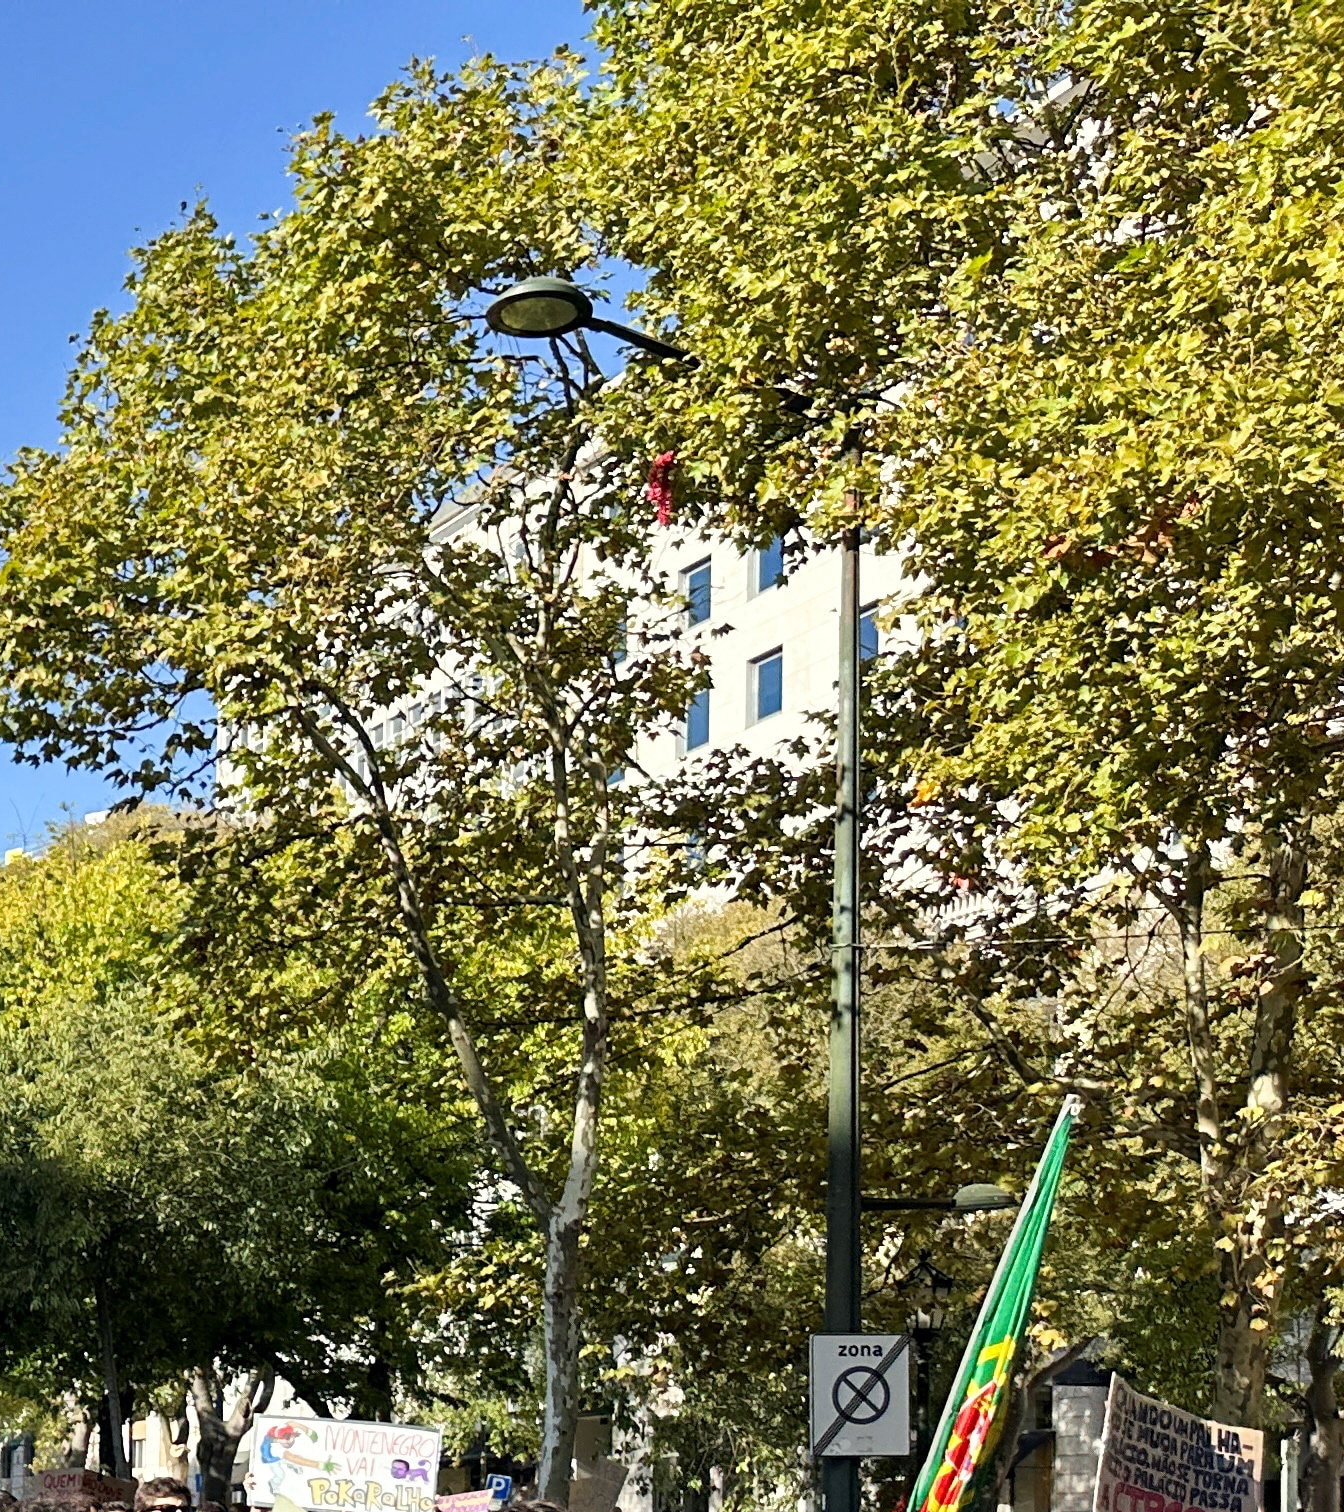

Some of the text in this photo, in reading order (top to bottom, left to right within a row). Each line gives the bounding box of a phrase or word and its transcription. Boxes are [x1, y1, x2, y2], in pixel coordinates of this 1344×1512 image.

[838, 1344, 884, 1358] zona
[324, 1424, 436, 1460] MONTENEGRO
[346, 1457, 375, 1477] VAI
[1215, 1449, 1255, 1479] UM
[43, 1473, 77, 1490] QUEM
[491, 1477, 506, 1494] P
[1192, 1467, 1250, 1497] TORNA
